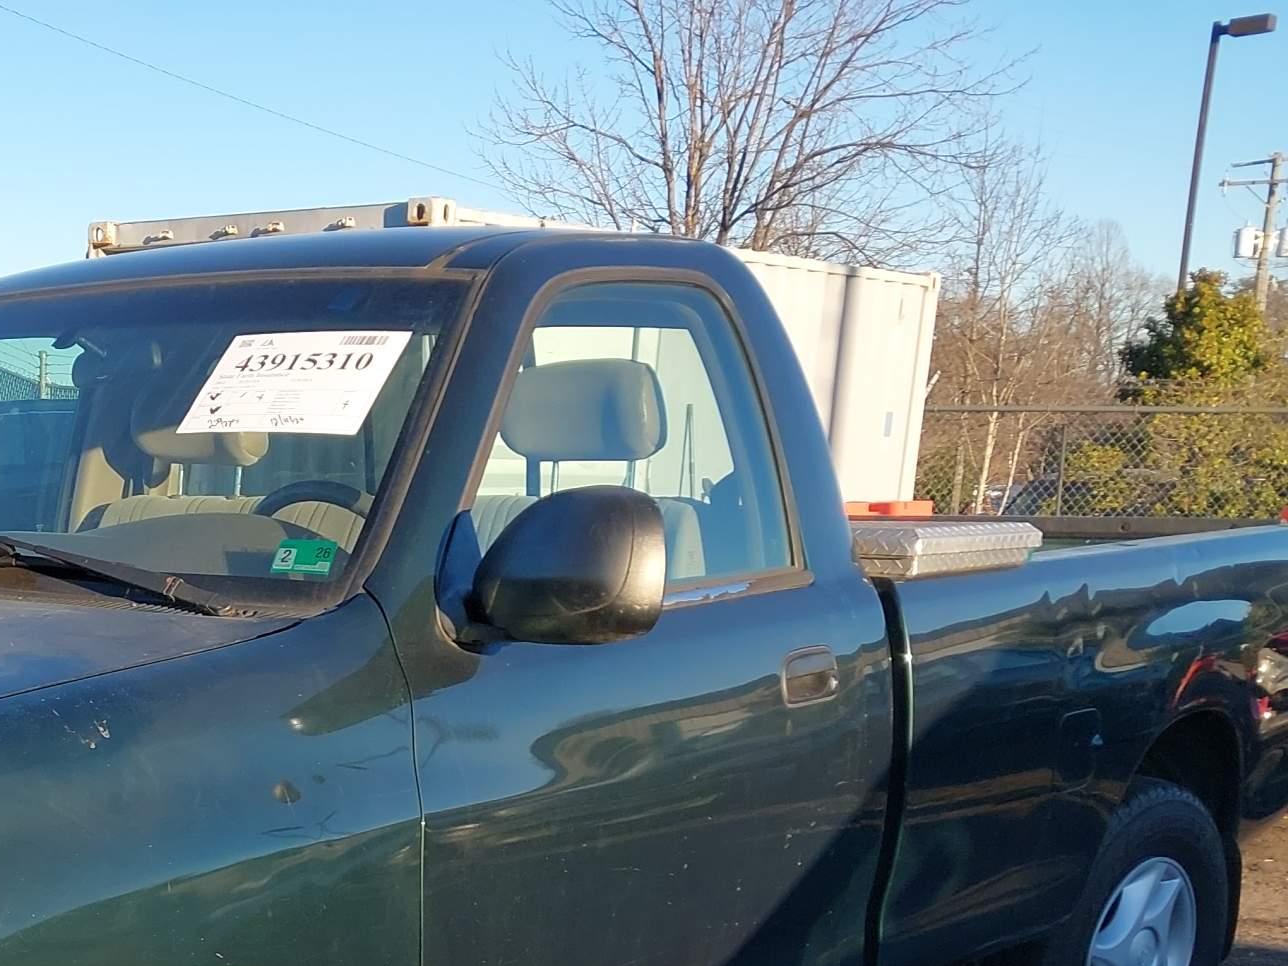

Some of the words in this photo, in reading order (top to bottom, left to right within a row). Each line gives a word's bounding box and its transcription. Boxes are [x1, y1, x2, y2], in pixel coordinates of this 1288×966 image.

[235, 352, 373, 372] 43915310
[280, 549, 292, 563] 2
[315, 547, 332, 559] 26
